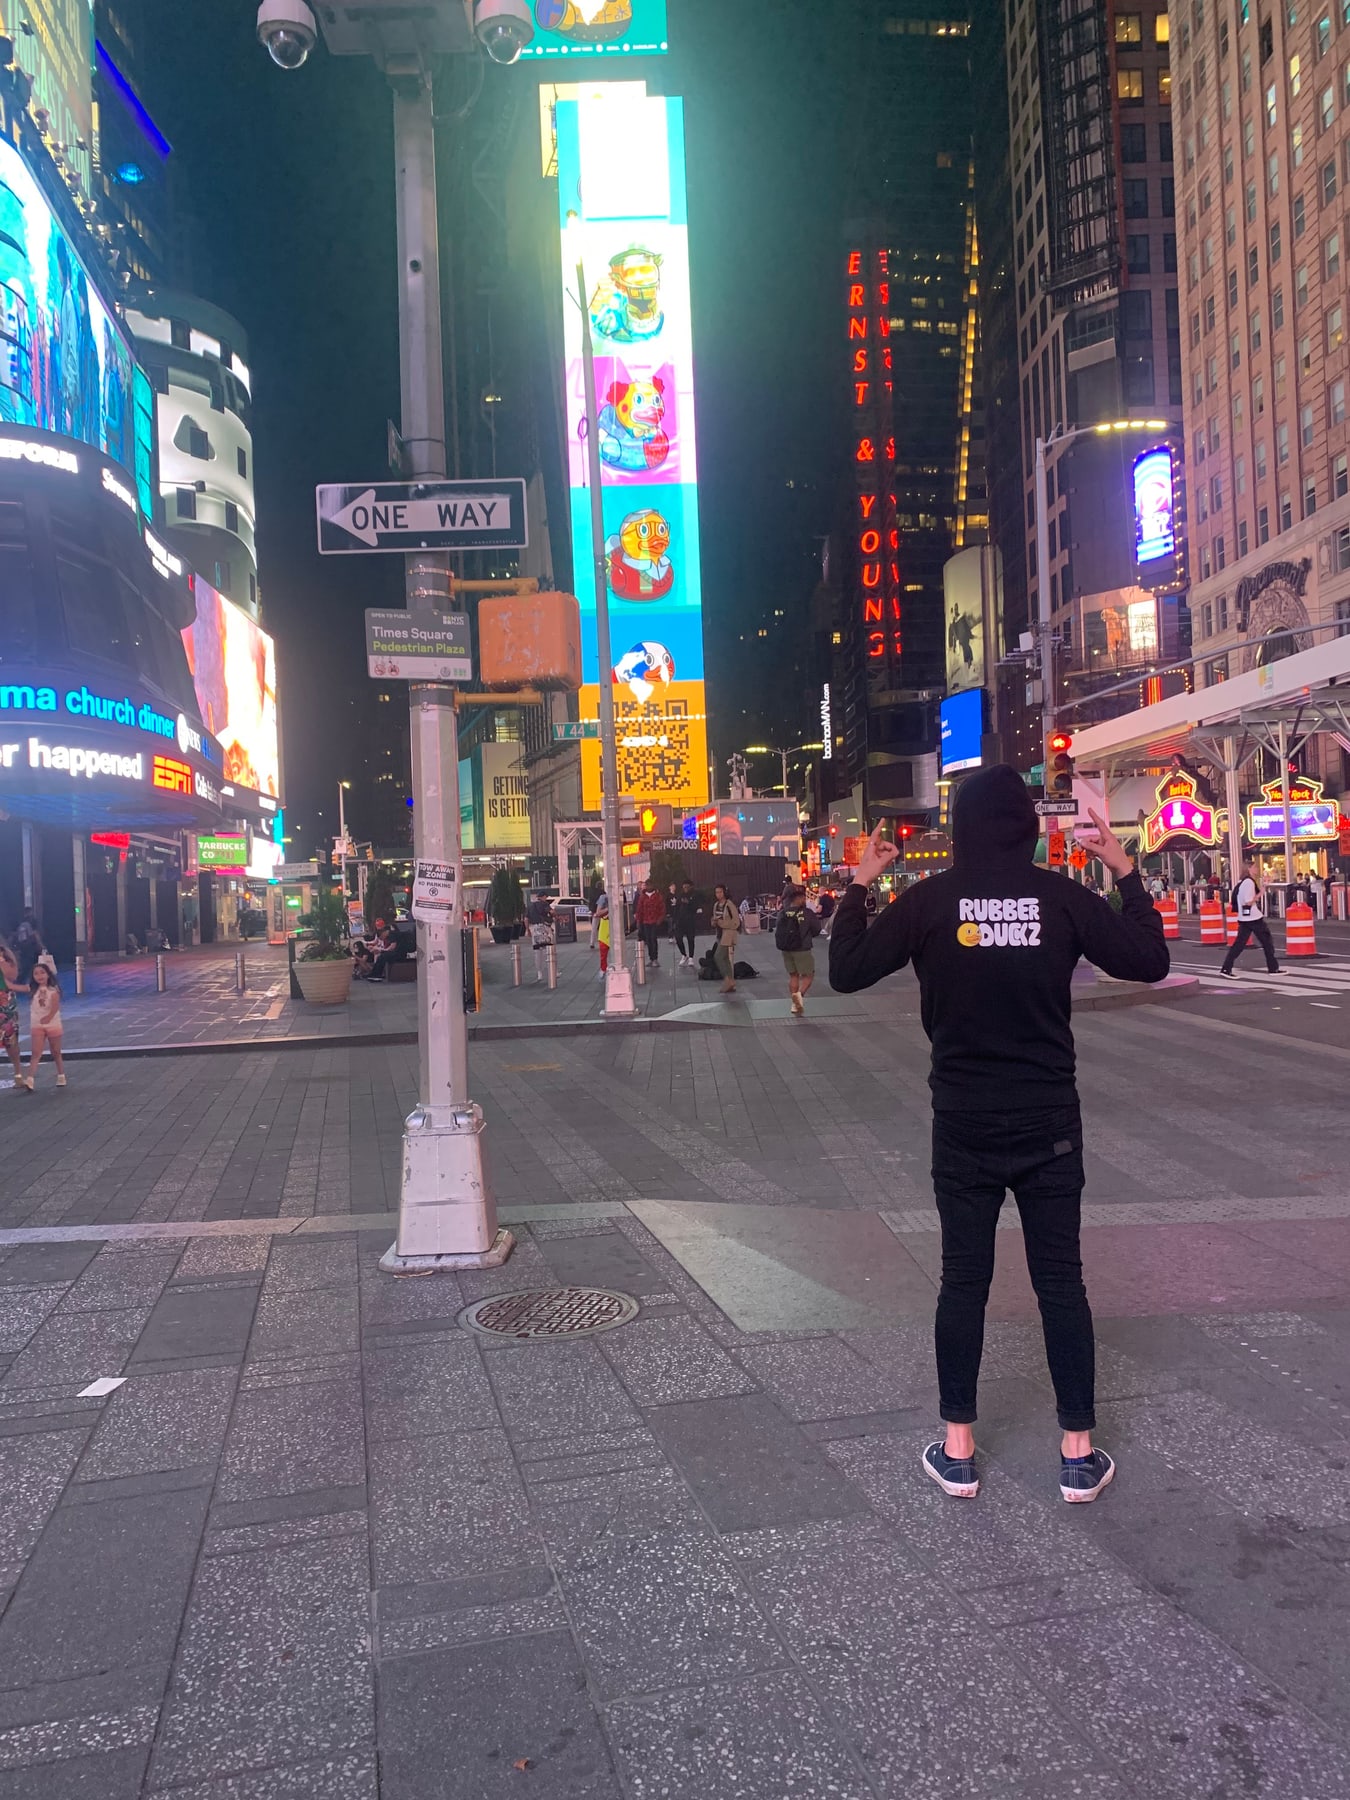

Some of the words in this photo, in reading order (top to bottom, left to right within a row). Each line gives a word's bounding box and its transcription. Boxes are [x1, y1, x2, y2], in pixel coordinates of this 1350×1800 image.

[848, 251, 868, 404] ERNST
[857, 438, 874, 460] &
[352, 505, 409, 530] ONE
[437, 502, 497, 527] WAY
[860, 496, 883, 656] YOUNG
[372, 626, 409, 639] Times
[411, 628, 453, 641] Square
[373, 641, 434, 653] Pedestrian
[436, 643, 465, 654] Plaza
[65, 687, 135, 727] church
[138, 703, 175, 739] dinner
[821, 683, 832, 760] boohooMAN.com
[556, 725, 566, 738] W
[569, 724, 585, 736] 44
[589, 723, 596, 731] ST
[0, 743, 19, 768] r
[28, 737, 143, 779] happened
[153, 755, 193, 795] ESPN
[493, 775, 529, 796] GETTING
[488, 798, 498, 818] IS
[1035, 804, 1049, 812] ONE
[663, 840, 697, 850] HOTDOGS
[425, 871, 447, 880] ZONE
[435, 866, 454, 874] AWAY
[426, 881, 451, 889] PARKING
[959, 898, 1040, 922] RUBBER
[978, 922, 1041, 947] DUCKZ
